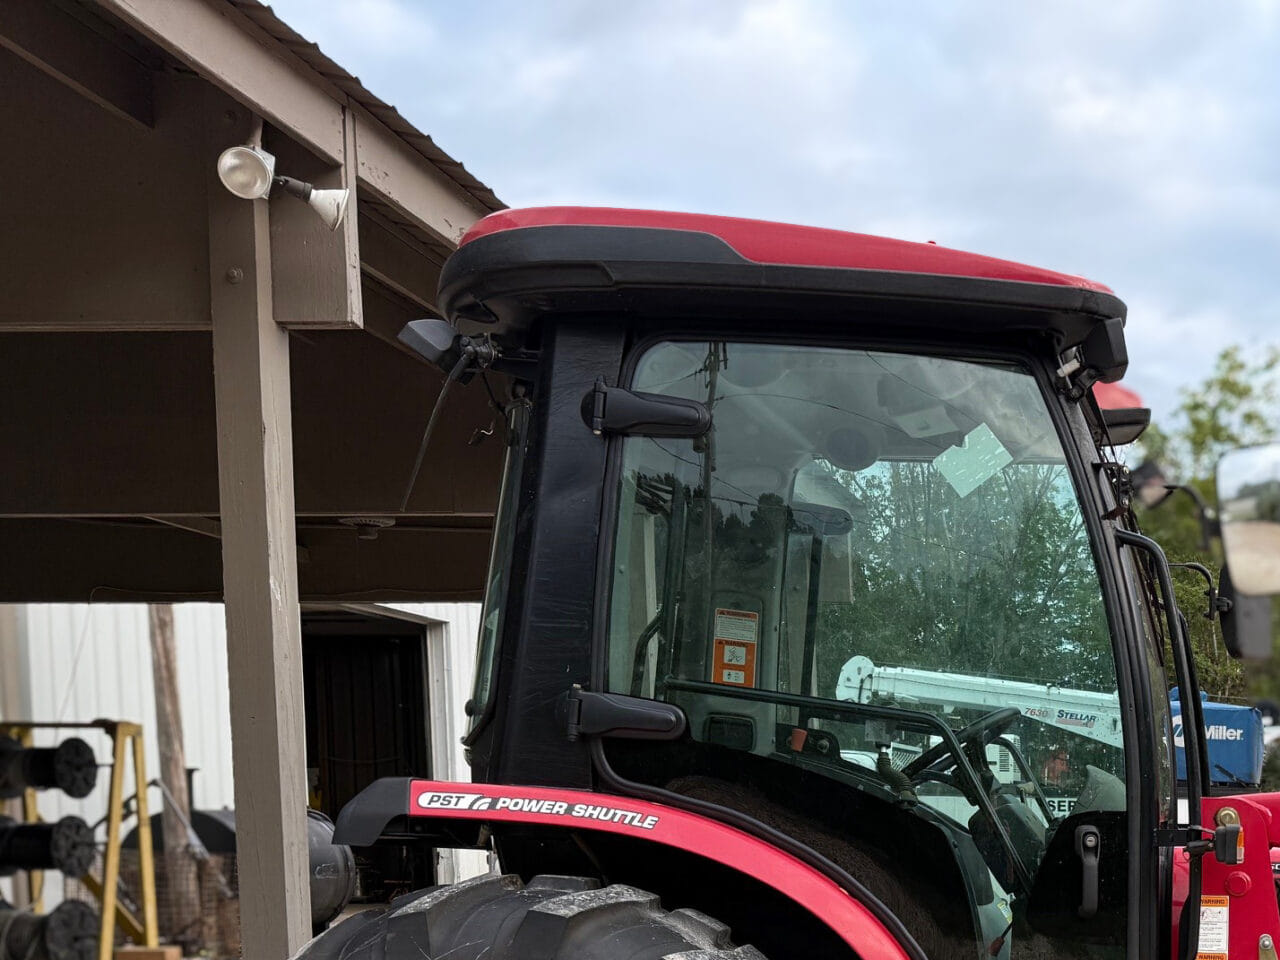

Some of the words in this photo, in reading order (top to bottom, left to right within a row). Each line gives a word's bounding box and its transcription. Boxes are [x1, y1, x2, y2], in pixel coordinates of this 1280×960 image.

[1025, 708, 1049, 718] 7630
[1057, 709, 1096, 722] STELLAR
[1204, 725, 1243, 741] Miller
[427, 794, 465, 807] PST
[496, 797, 568, 815] POWER
[571, 803, 659, 829] SHUTTLE
